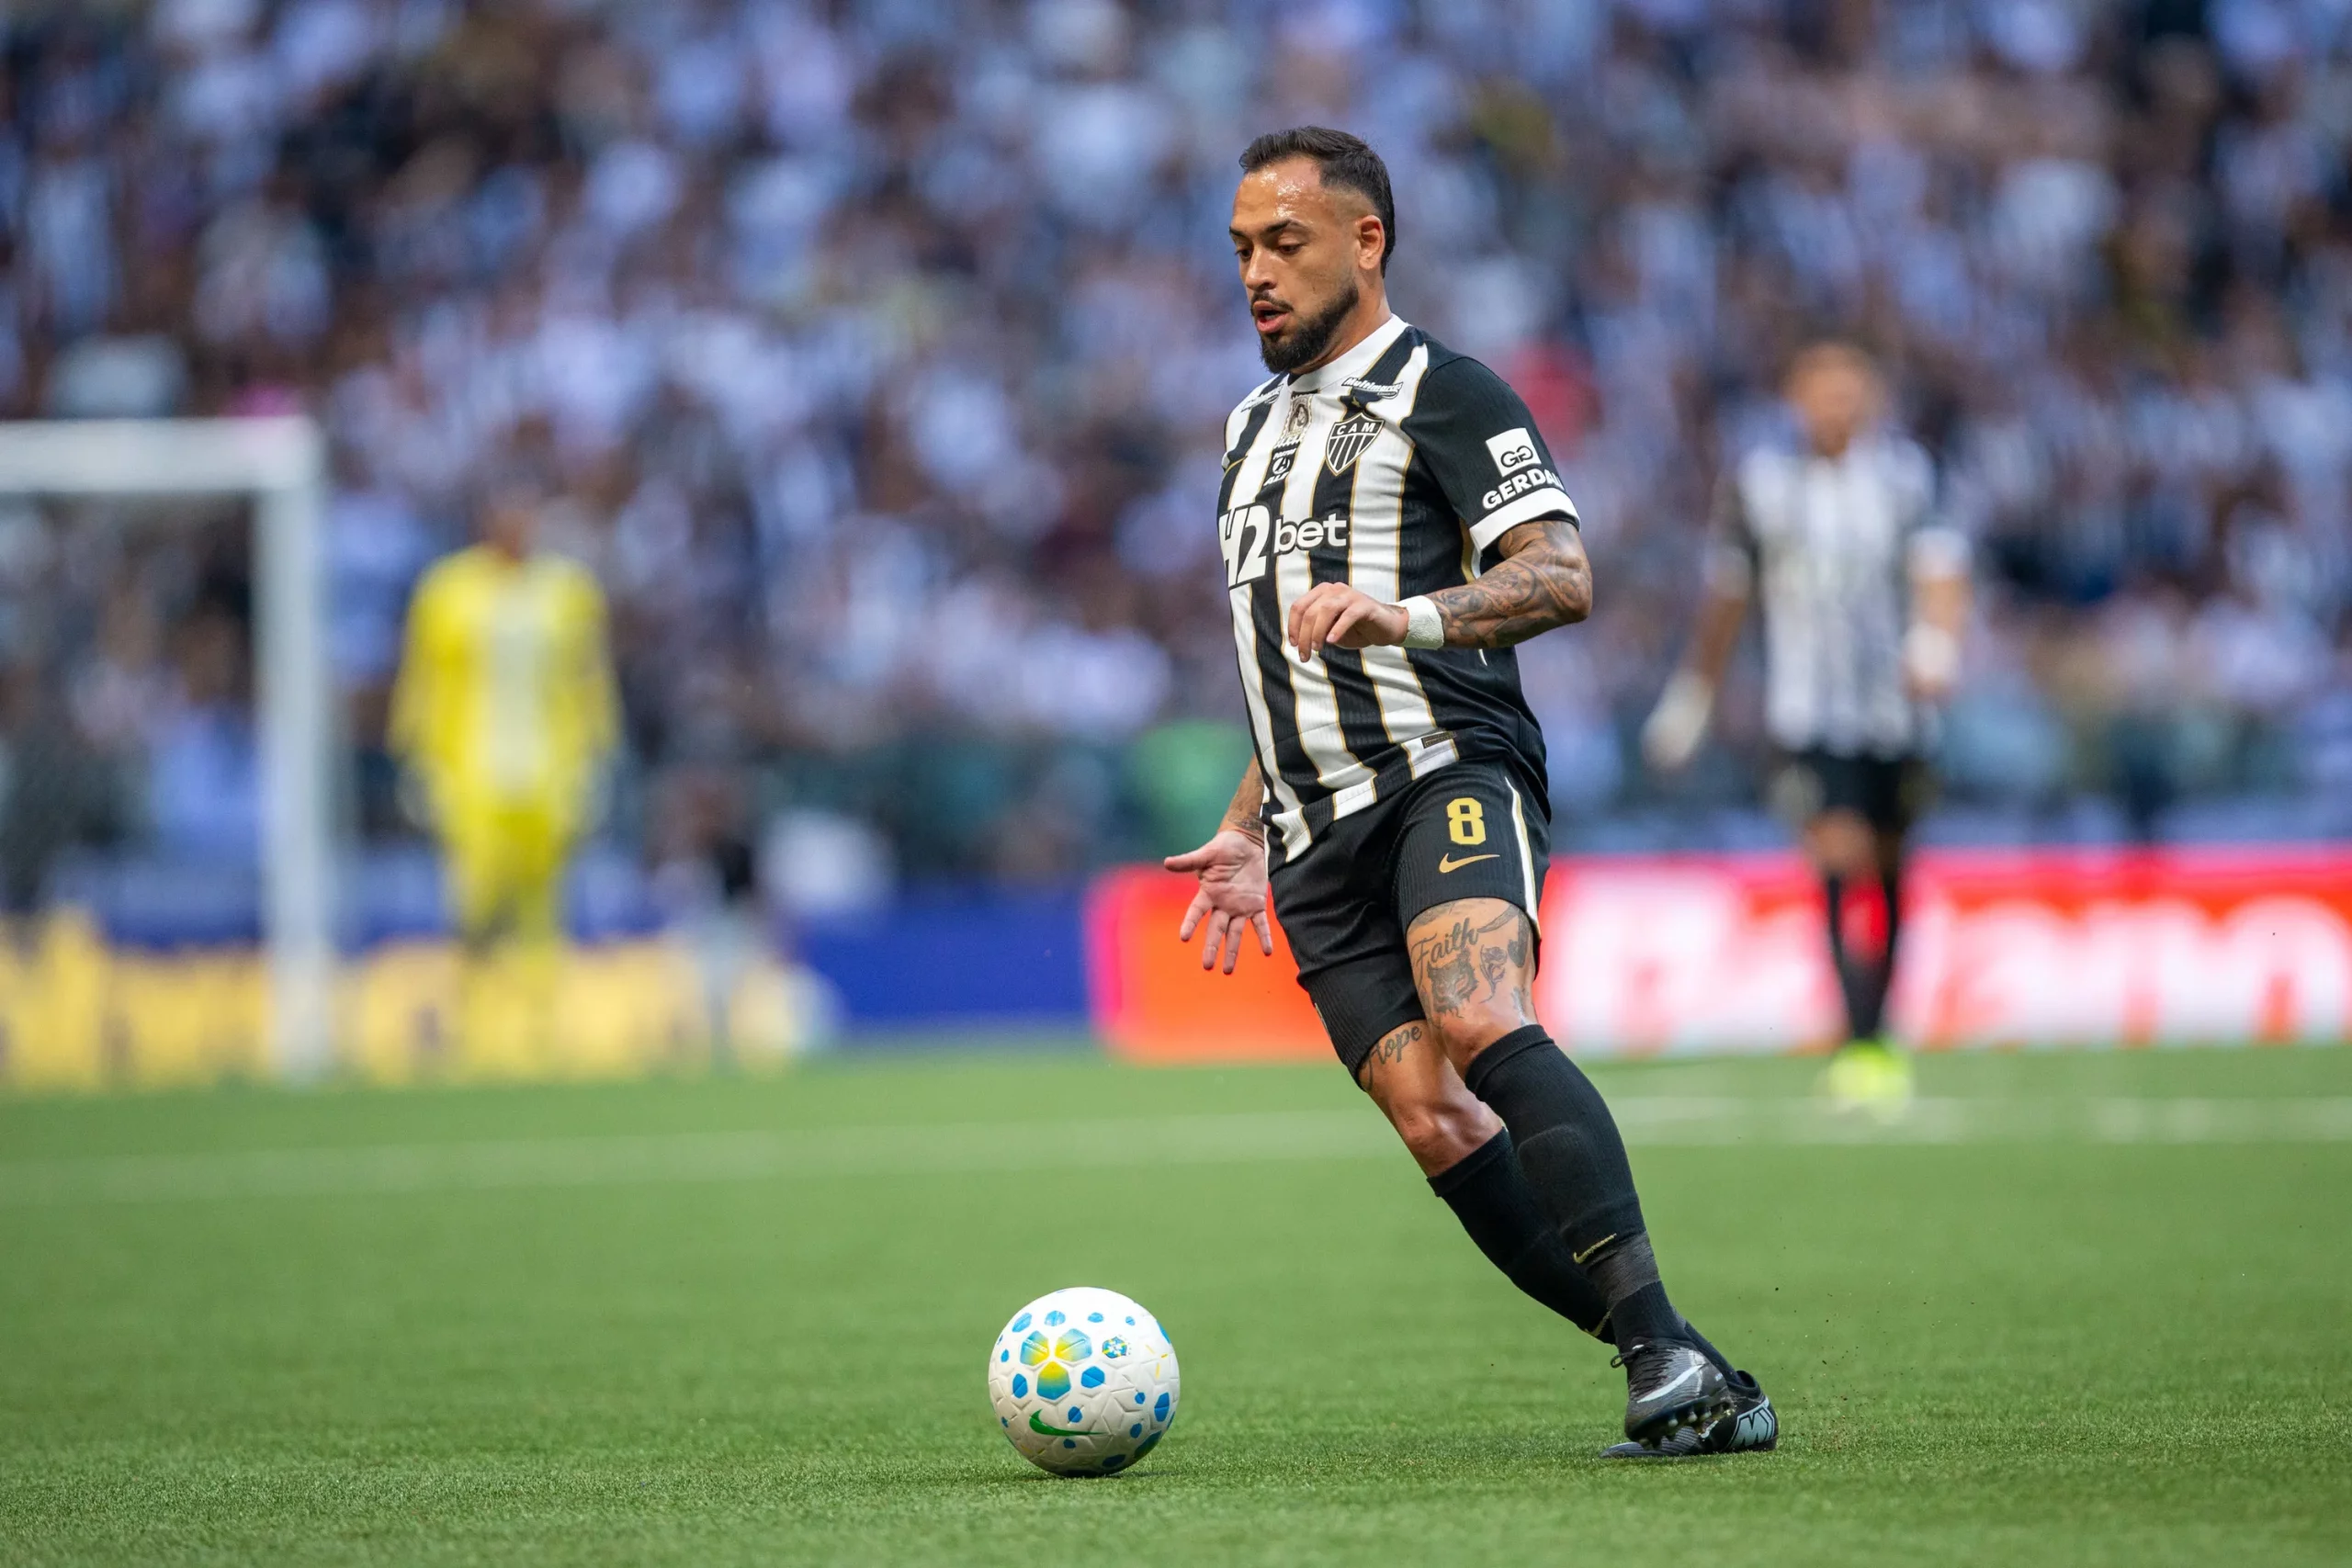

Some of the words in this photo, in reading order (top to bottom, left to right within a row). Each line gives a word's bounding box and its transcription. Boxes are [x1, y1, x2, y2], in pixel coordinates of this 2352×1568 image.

[1337, 422, 1376, 435] CAM
[1446, 797, 1487, 845] 8
[1410, 917, 1479, 989] Faith
